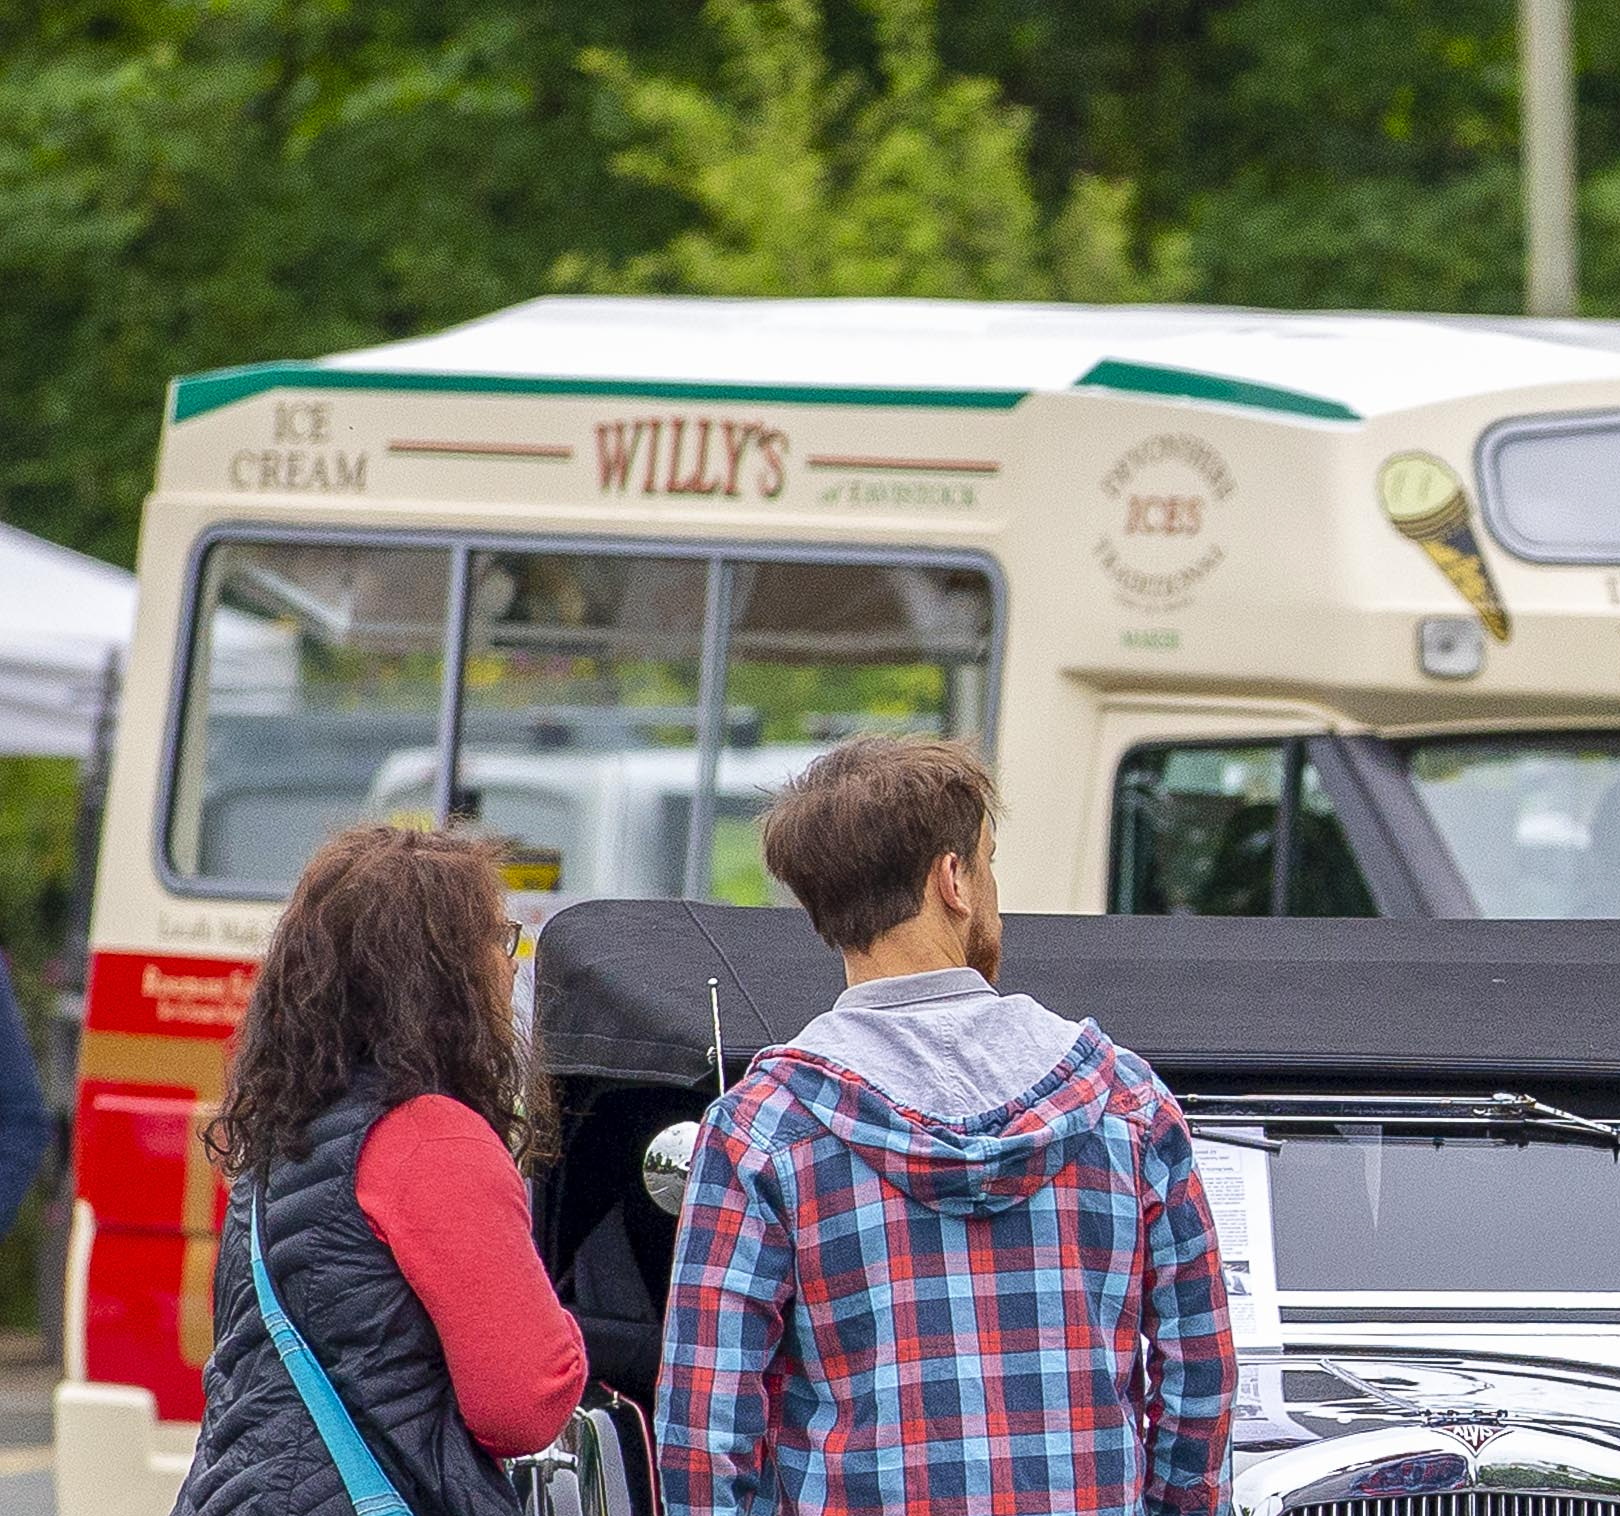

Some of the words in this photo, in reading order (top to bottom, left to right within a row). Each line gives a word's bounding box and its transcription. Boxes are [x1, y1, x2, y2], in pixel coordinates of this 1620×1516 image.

[273, 401, 333, 443] ICE
[229, 450, 368, 493] CREAM
[594, 415, 789, 499] WILLY'S
[1123, 493, 1205, 538] ICES
[1453, 1425, 1494, 1446] ALVIS
